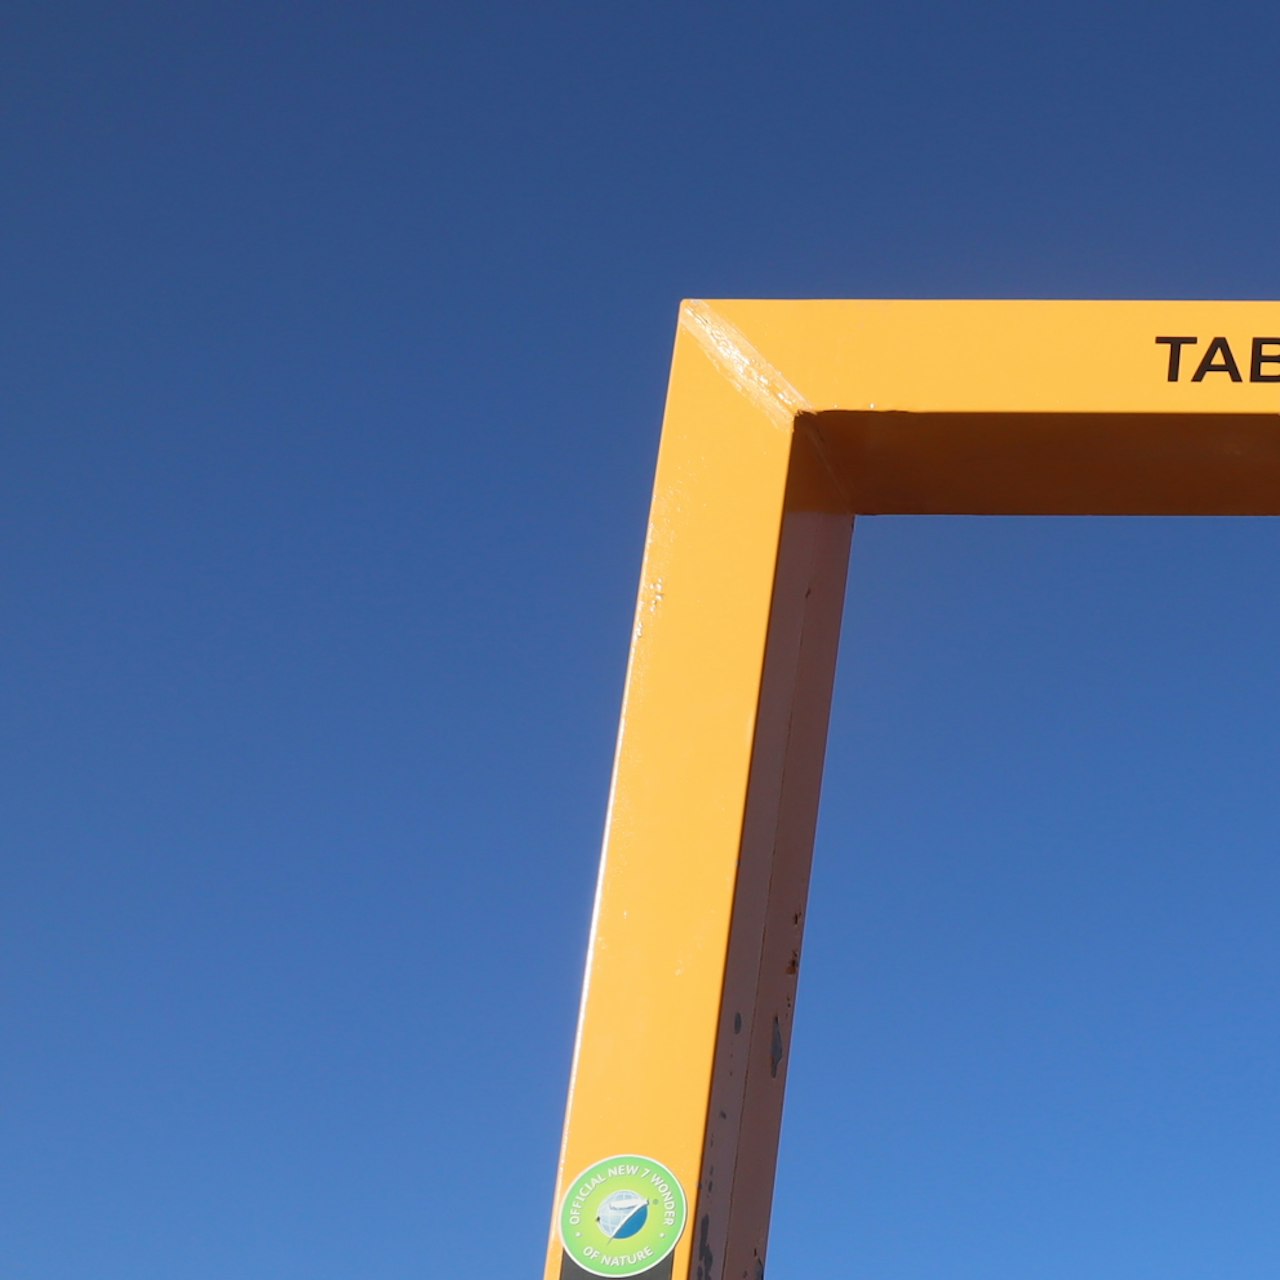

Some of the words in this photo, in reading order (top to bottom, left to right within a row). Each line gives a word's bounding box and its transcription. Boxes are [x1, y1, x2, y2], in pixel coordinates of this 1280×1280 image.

[569, 1172, 607, 1226] OFFICIAL
[608, 1164, 639, 1178] NEW
[641, 1168, 651, 1178] 7
[651, 1174, 676, 1227] WONDER
[583, 1245, 601, 1261] OF
[602, 1246, 655, 1268] NATURE
